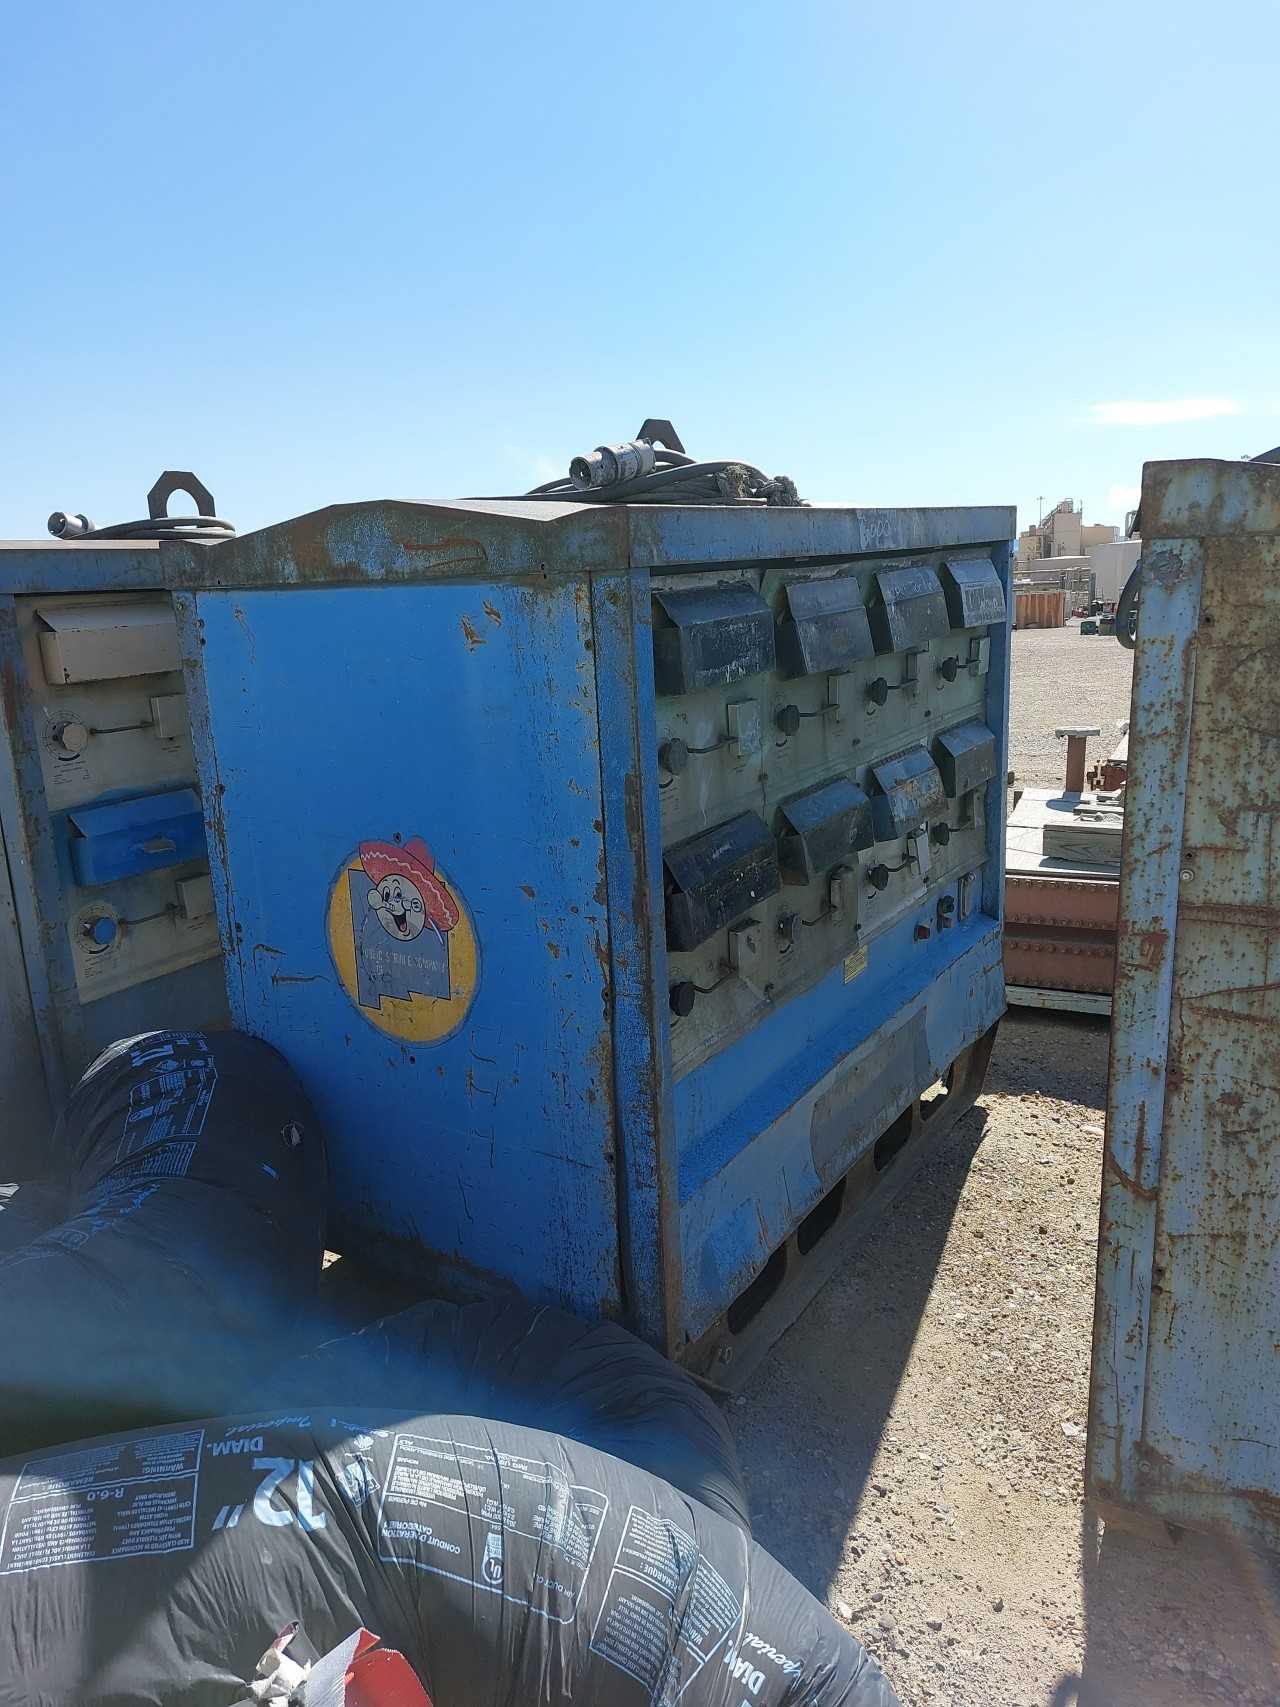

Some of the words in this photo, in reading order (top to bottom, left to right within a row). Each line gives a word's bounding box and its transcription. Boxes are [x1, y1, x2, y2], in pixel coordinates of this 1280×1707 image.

[206, 1436, 264, 1456] DIAM.
[87, 1487, 124, 1501] R-6.0
[428, 1536, 461, 1554] CONDUIT
[643, 1564, 679, 1593] REMARQUE
